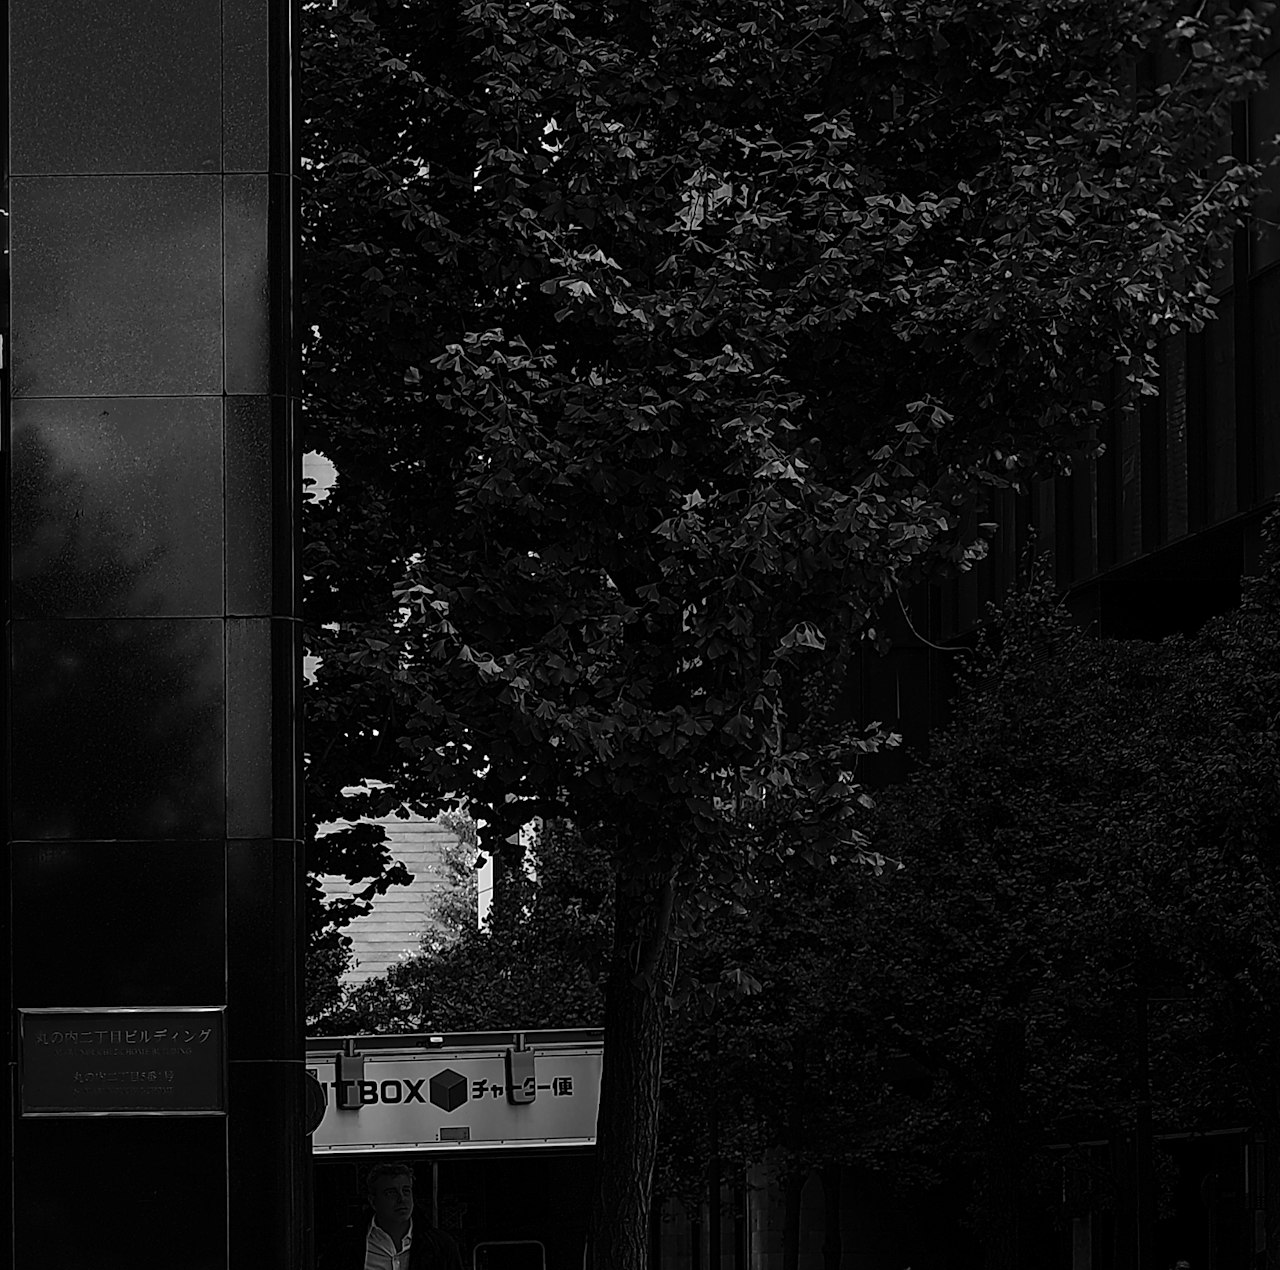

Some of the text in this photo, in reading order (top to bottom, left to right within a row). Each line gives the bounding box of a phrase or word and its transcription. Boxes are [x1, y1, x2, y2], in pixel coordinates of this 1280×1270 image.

[36, 1028, 213, 1046] 丸の内二丁目ビルディング
